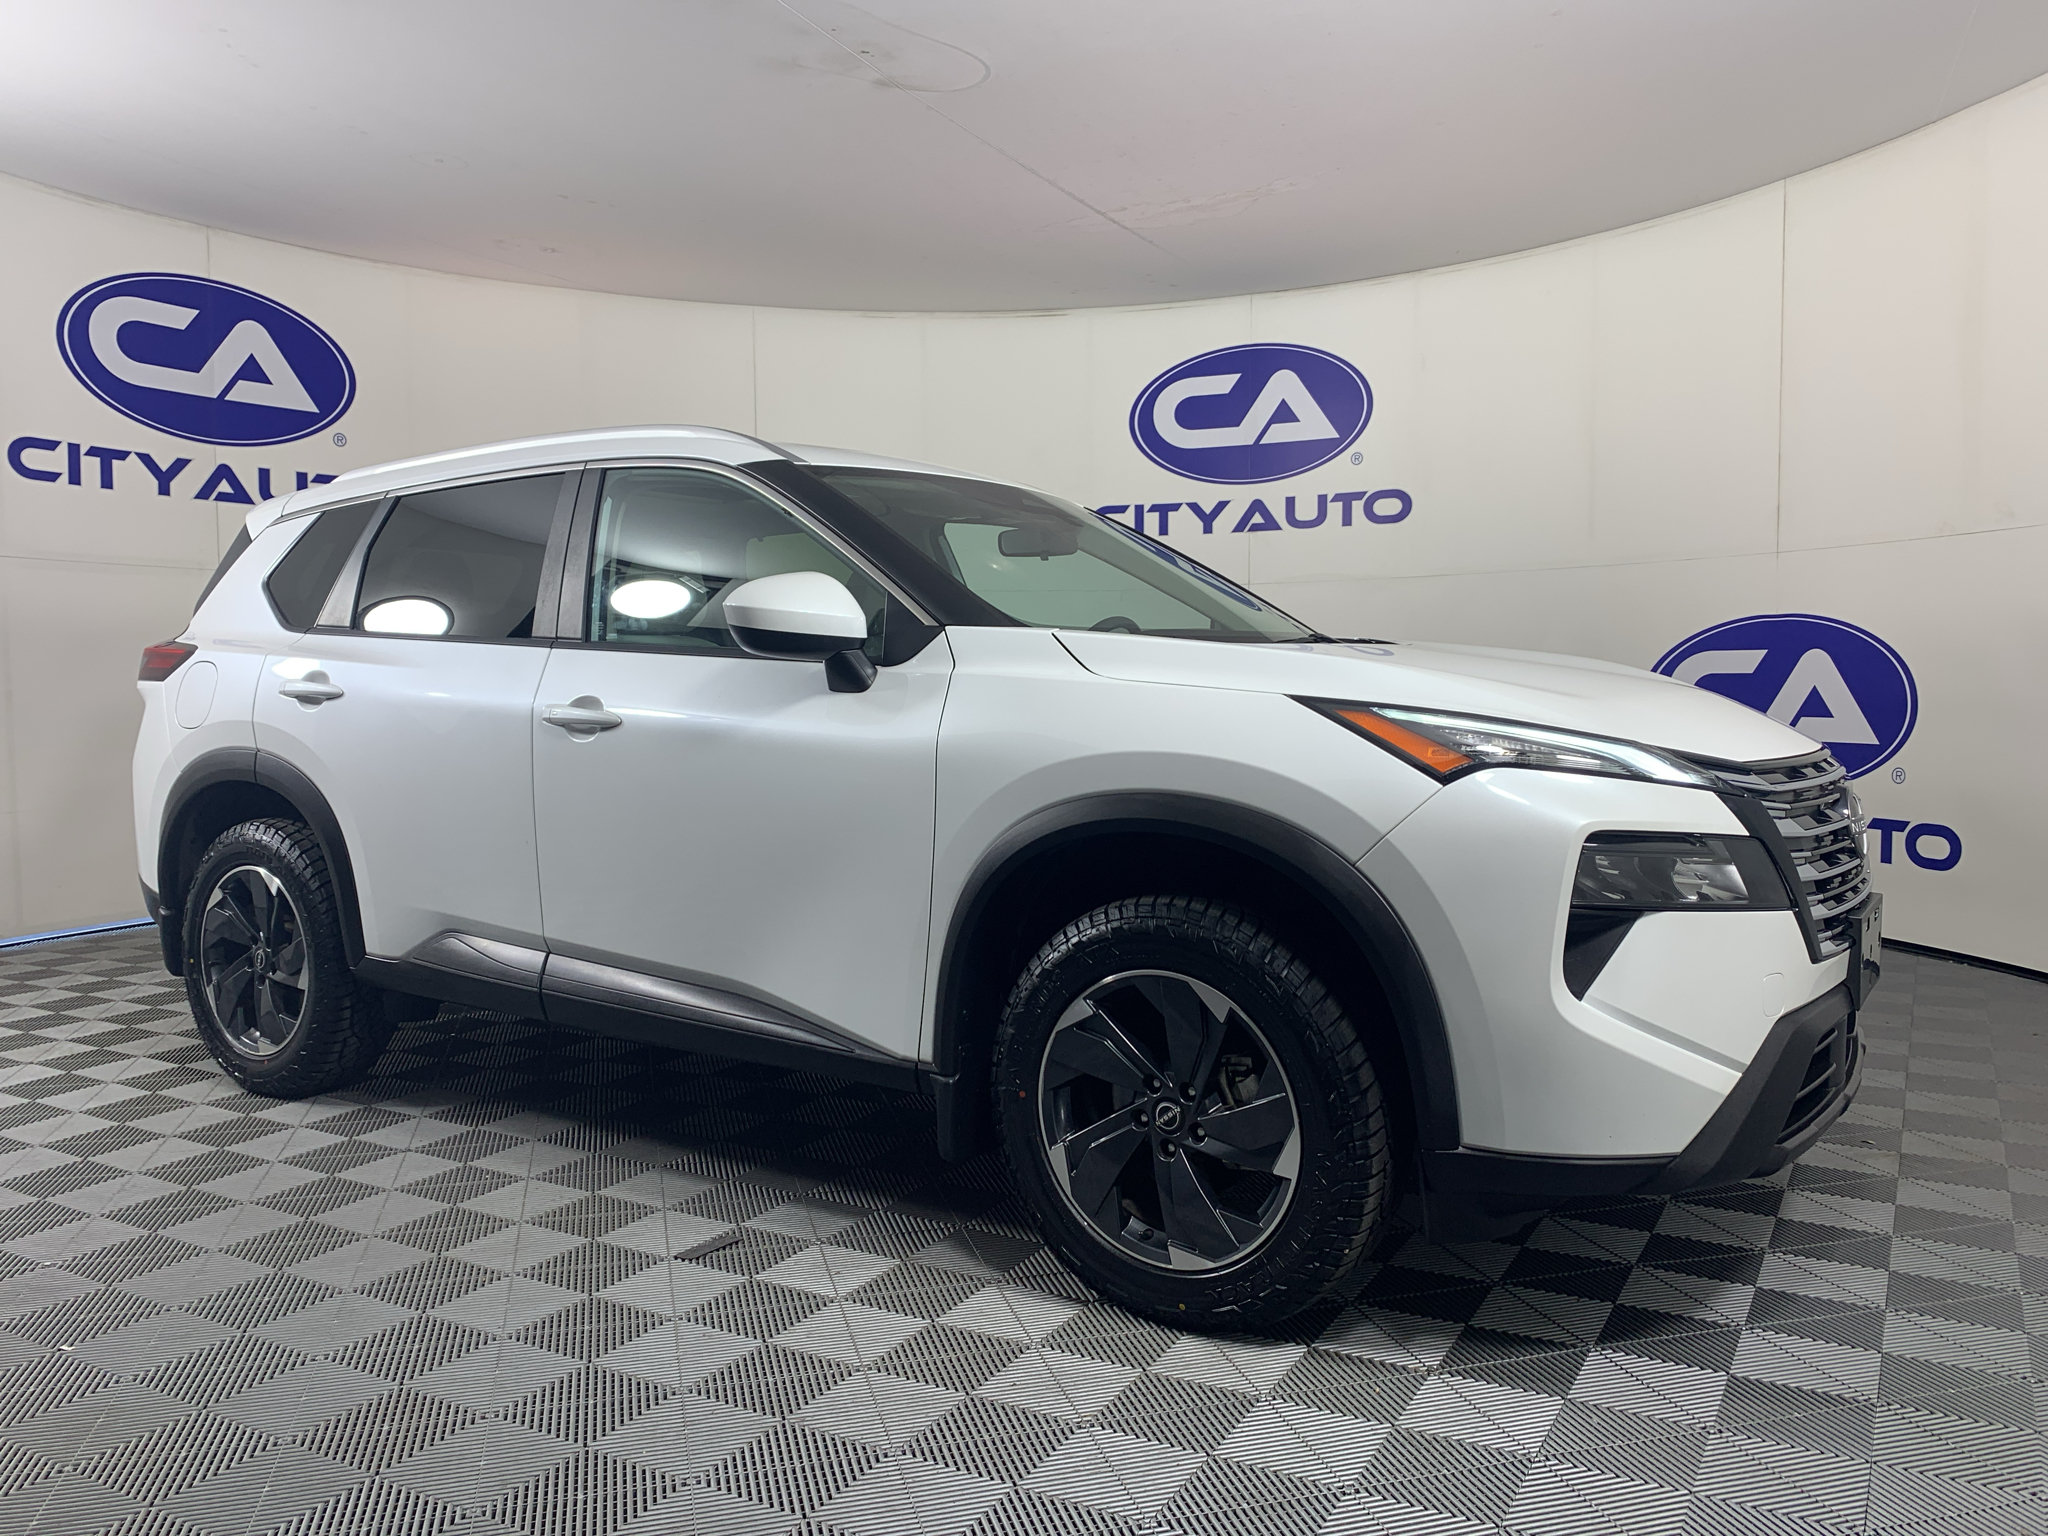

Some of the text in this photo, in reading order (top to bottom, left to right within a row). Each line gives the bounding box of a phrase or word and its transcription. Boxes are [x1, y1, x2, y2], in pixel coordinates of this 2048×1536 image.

[88, 296, 320, 413] CA
[1153, 369, 1340, 449] CA
[1851, 820, 1867, 833] NIS
[1867, 817, 1962, 872] TO
